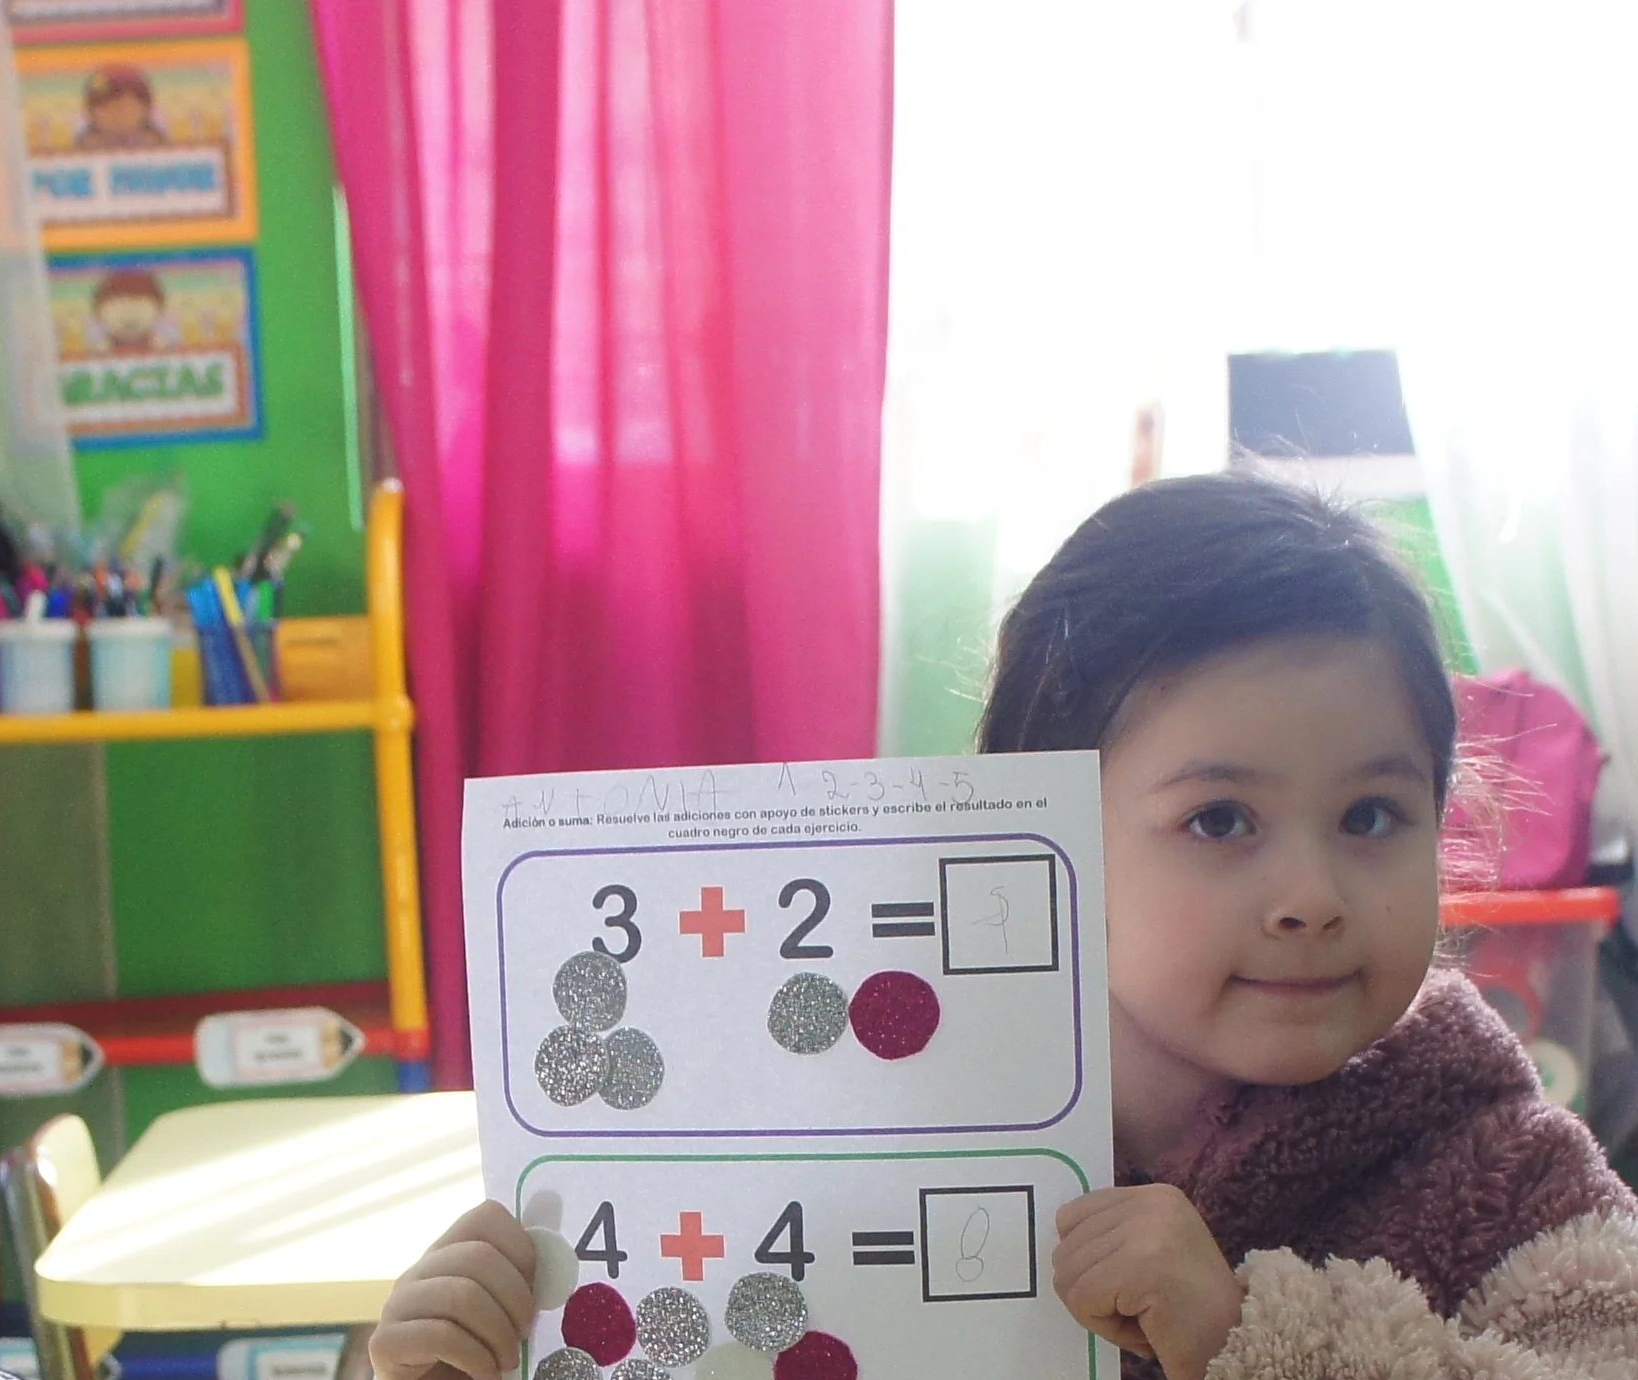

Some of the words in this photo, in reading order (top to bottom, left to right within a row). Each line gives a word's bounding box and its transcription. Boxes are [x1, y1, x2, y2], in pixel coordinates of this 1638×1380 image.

[503, 816, 545, 828] Adición
[559, 816, 593, 826] suma:
[597, 814, 650, 825] Resuelve
[653, 812, 670, 822] las
[673, 809, 731, 822] adiciones
[735, 809, 756, 820] con
[760, 808, 797, 821] apoyo
[801, 806, 815, 816] de
[819, 804, 868, 816] stickers
[871, 806, 879, 816] y
[883, 802, 931, 813] escribe
[935, 802, 946, 812] el
[951, 800, 1012, 811] resultado
[1017, 801, 1031, 809] en
[1035, 798, 1047, 808] el
[668, 826, 710, 838] cuadro
[713, 828, 749, 838] negro
[752, 825, 767, 836] de
[771, 824, 800, 834] cada
[804, 822, 861, 835] ejercicio.
[591, 884, 642, 964] 3
[778, 878, 833, 959] 2
[871, 902, 935, 938] =
[575, 1201, 627, 1279] 4
[754, 1201, 815, 1281] 4
[852, 1231, 915, 1266] =
